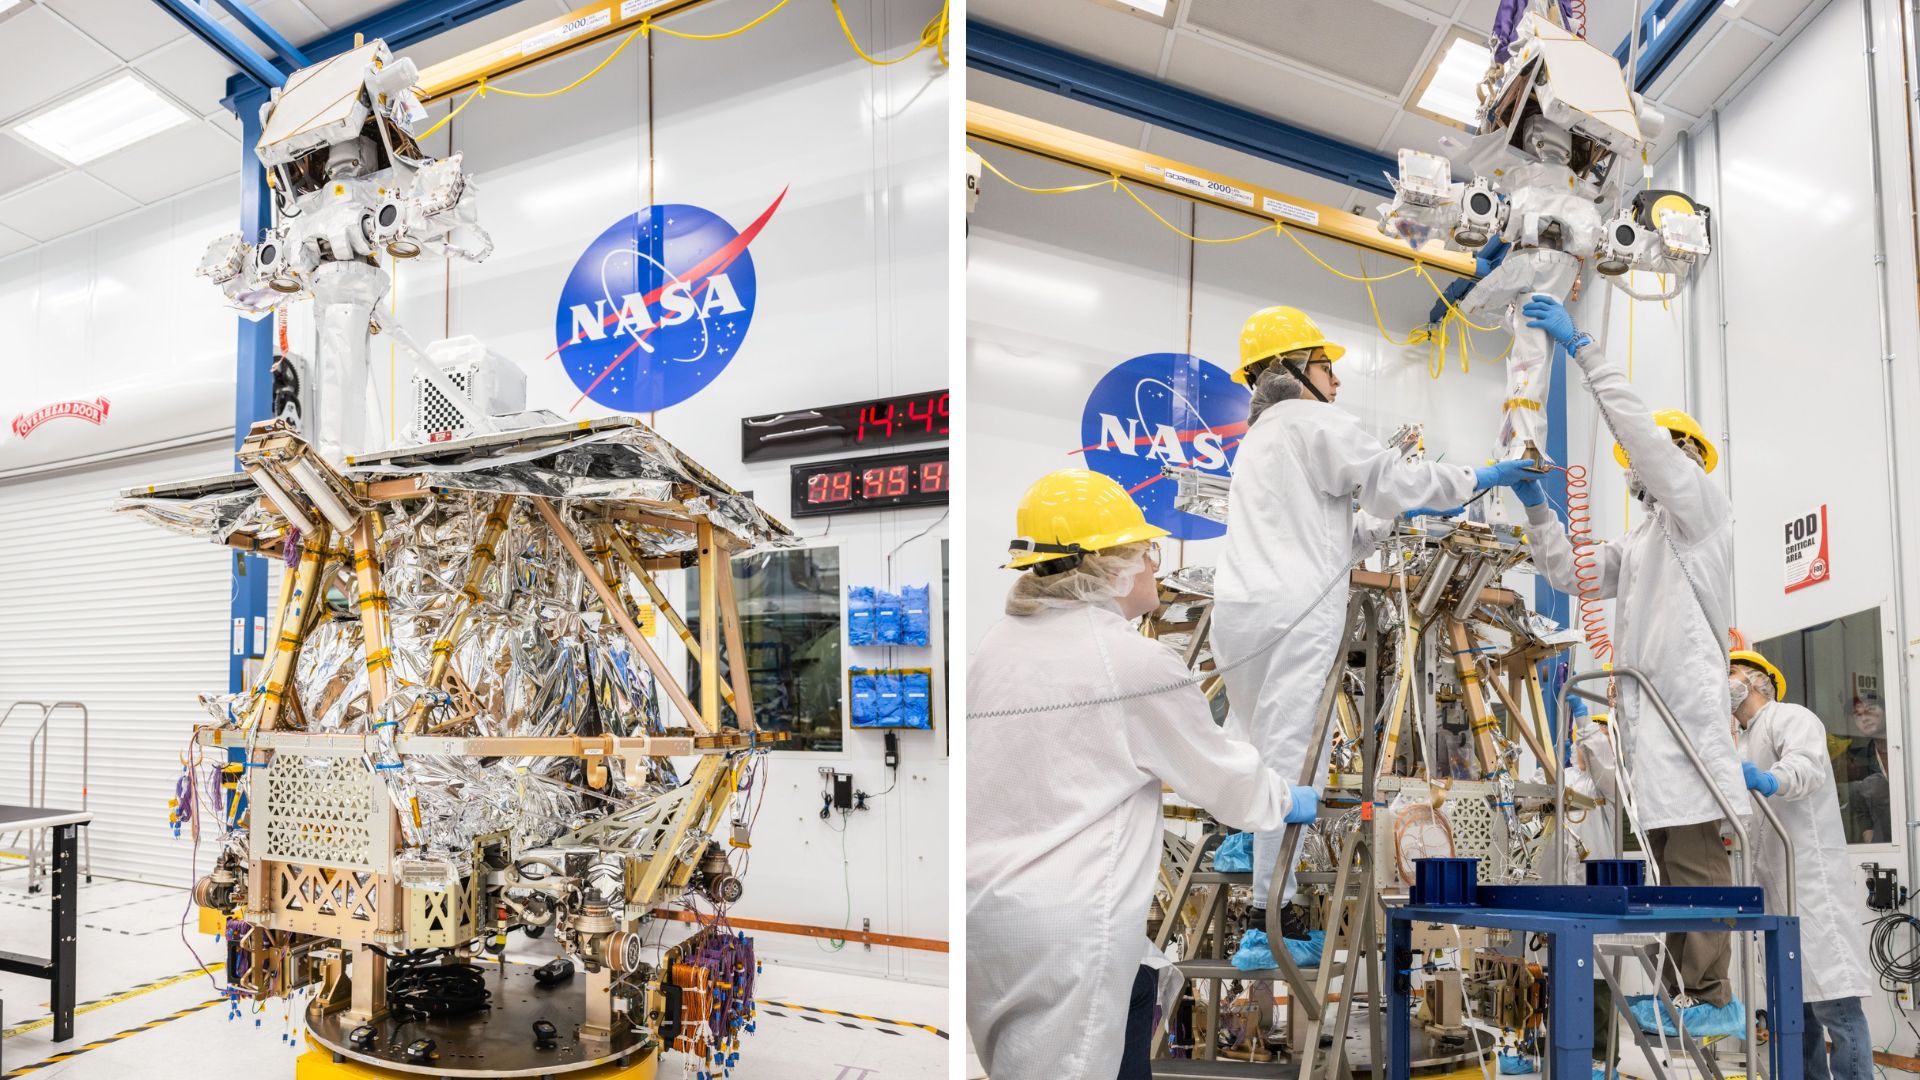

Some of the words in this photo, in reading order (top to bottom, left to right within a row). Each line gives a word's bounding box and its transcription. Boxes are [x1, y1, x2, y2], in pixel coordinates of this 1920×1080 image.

[561, 17, 586, 33] 2000
[1207, 181, 1231, 194] 2000
[569, 273, 746, 345] NASA
[20, 403, 71, 433] OVERHEAD
[73, 403, 99, 420] DOOR
[1096, 412, 1242, 472] NAS
[1785, 513, 1817, 545] FOD
[1785, 538, 1815, 555] CRITICAL
[1785, 551, 1803, 564] AREA
[1813, 564, 1823, 573] FOD
